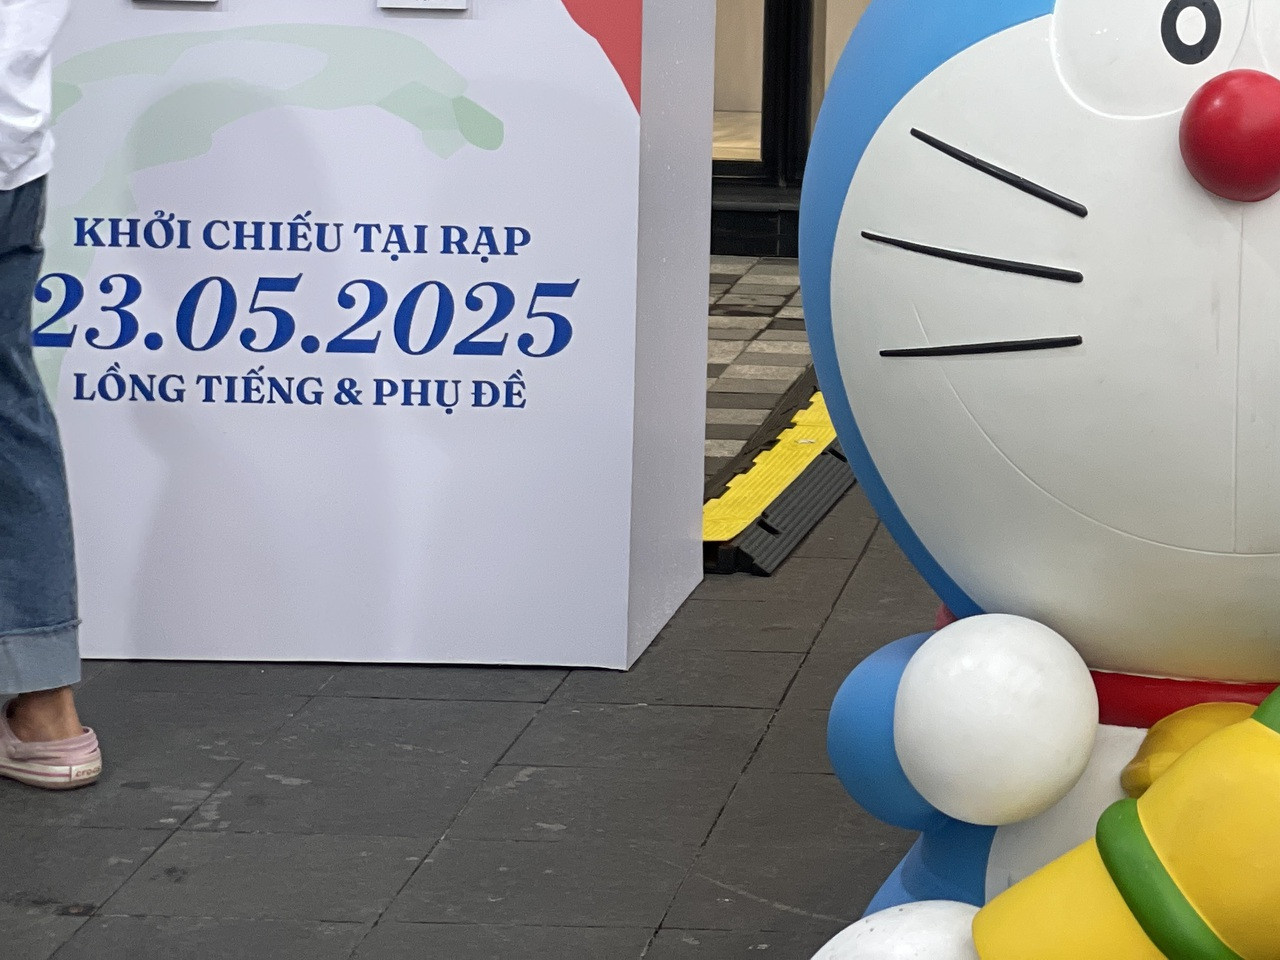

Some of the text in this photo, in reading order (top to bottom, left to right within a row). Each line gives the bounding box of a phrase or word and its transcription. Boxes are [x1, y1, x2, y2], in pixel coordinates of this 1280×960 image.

[74, 210, 531, 264] KHỞI CHIẾU TẠI RẠP
[32, 272, 581, 358] 23.05.2025
[74, 363, 528, 415] LỒNG TIẾNG & PHỤ ĐỀ
